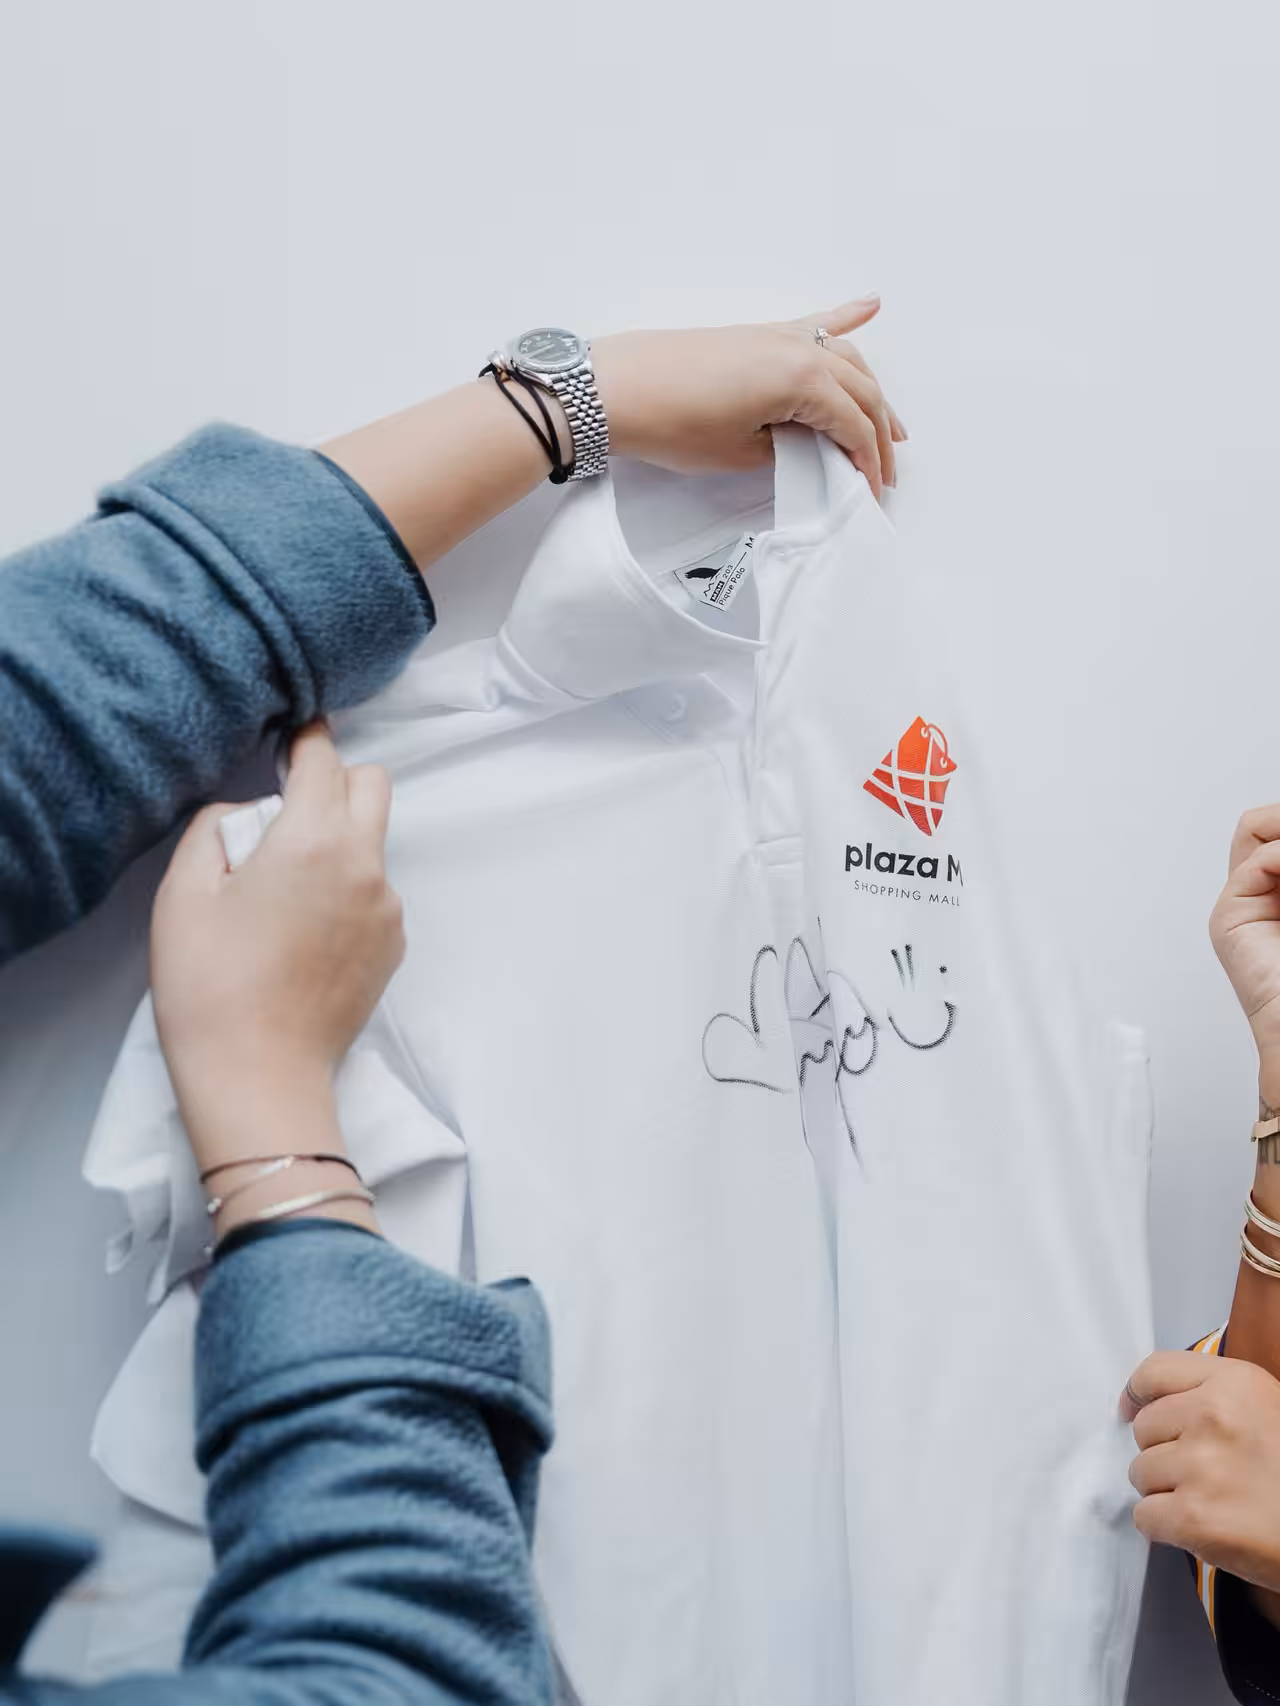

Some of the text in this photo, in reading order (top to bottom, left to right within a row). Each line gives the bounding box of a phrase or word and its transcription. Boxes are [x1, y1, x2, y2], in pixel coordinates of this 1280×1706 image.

[718, 567, 745, 605] Pique Polo
[722, 564, 733, 579] 203
[845, 842, 964, 887] plaza M
[854, 880, 961, 906] SHOPPING MALL
